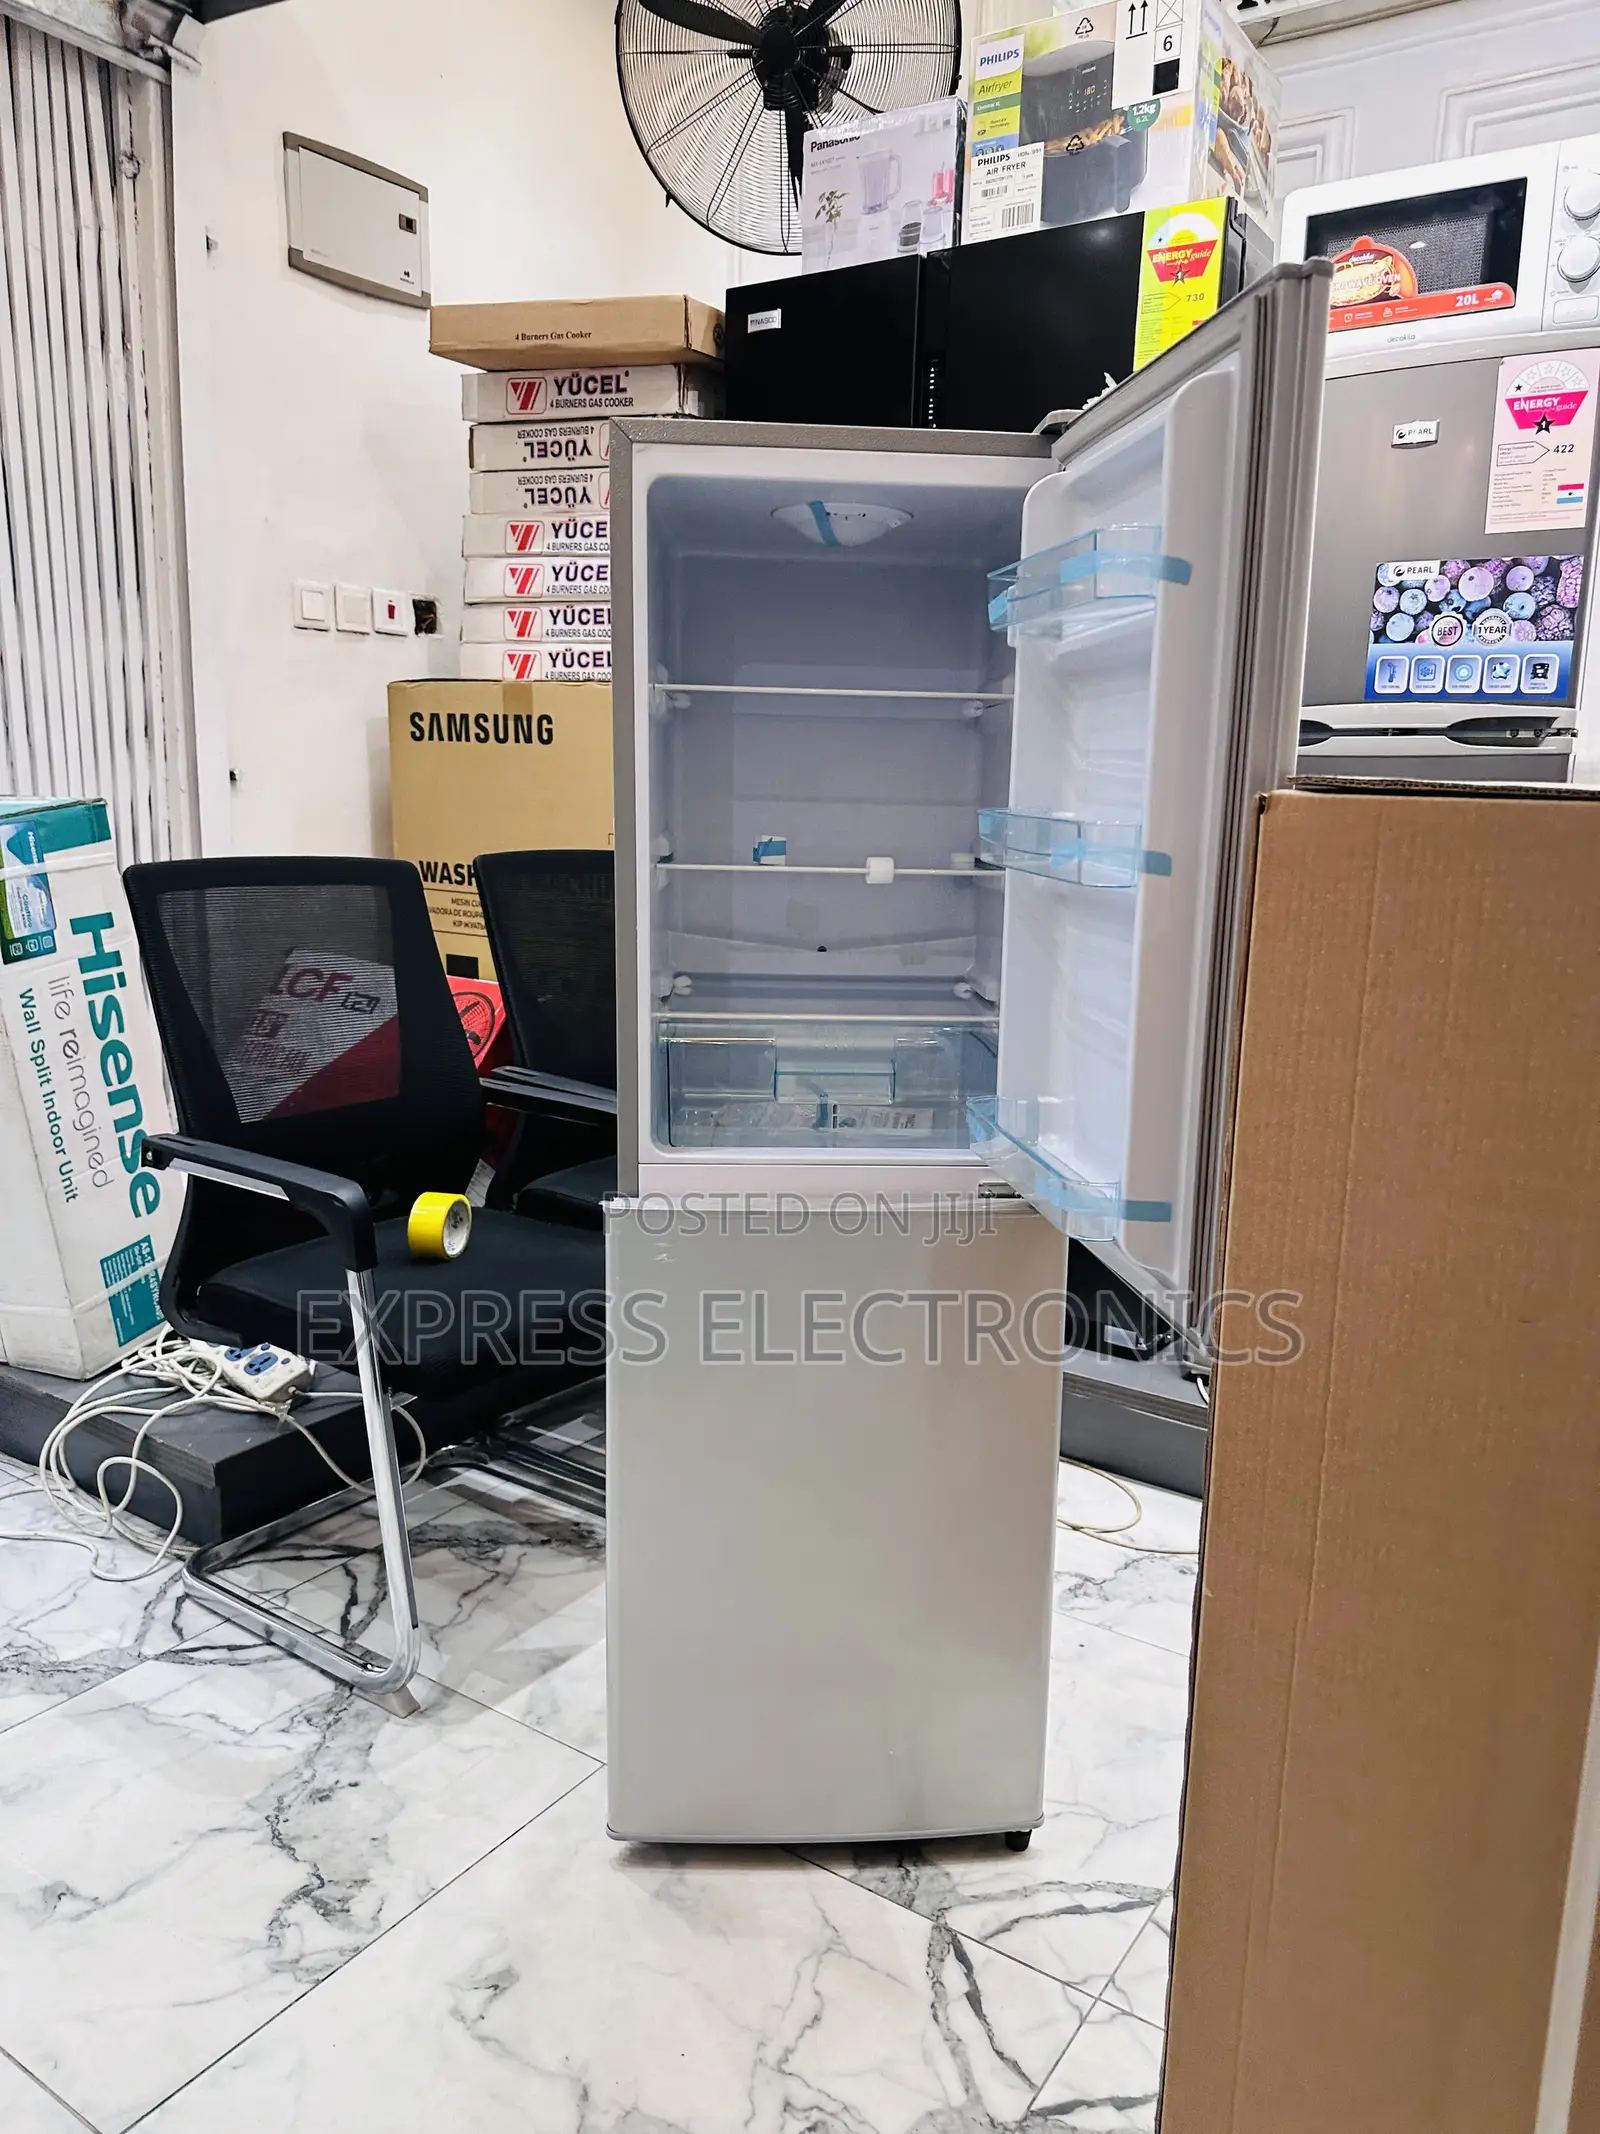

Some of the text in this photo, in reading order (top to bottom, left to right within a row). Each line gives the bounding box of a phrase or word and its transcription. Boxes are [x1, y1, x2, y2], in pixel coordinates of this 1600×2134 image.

[1163, 34, 1173, 51] 6
[979, 48, 1020, 67] PHILIPS
[978, 79, 1012, 96] Airfryer
[977, 153, 1010, 167] PHILIPS
[986, 161, 1026, 176] AIR FRYER
[1152, 249, 1213, 265] ENERGY guide
[1376, 273, 1401, 284] OVEN
[1186, 293, 1205, 303] 730
[1455, 293, 1479, 307] 20L
[521, 333, 549, 341] Burners
[550, 332, 565, 340] Gas
[566, 331, 592, 339] Cooker
[553, 371, 628, 396] YÜCEL
[549, 397, 634, 409] 4 BURNERS GAS COOKER
[1513, 397, 1578, 413] ENERGY guide
[1540, 420, 1546, 429] 1
[517, 425, 595, 439] 4 BURNERS GAS COOKER
[524, 438, 592, 461] YÜCEL
[1553, 444, 1575, 454] 422
[517, 473, 594, 486] 4 BURNERS GAS COOKER
[524, 486, 592, 508] YÜCEL
[551, 518, 608, 539] YÜCE
[546, 542, 610, 551] 4 BURNERS GAS CO
[551, 561, 609, 582] YÜCE
[1406, 566, 1434, 574] PEARL
[546, 585, 611, 594] 4 BURNERS GAS CO
[545, 629, 550, 637] 4
[550, 629, 581, 638] BURNERS
[582, 629, 597, 638] GAS
[1437, 626, 1459, 636] BEST
[1483, 626, 1507, 634] YEAR
[545, 671, 549, 679] 4
[550, 671, 580, 680] BURNERS
[581, 671, 596, 680] GAS
[409, 711, 554, 745] SAMSUNG
[27, 831, 38, 866] Hisens
[419, 860, 475, 886] WASH
[471, 899, 481, 908] CU
[69, 912, 161, 1218] Hisense
[48, 976, 115, 1188] life reimagined
[19, 988, 79, 1203] Wall Split Indoor Unit
